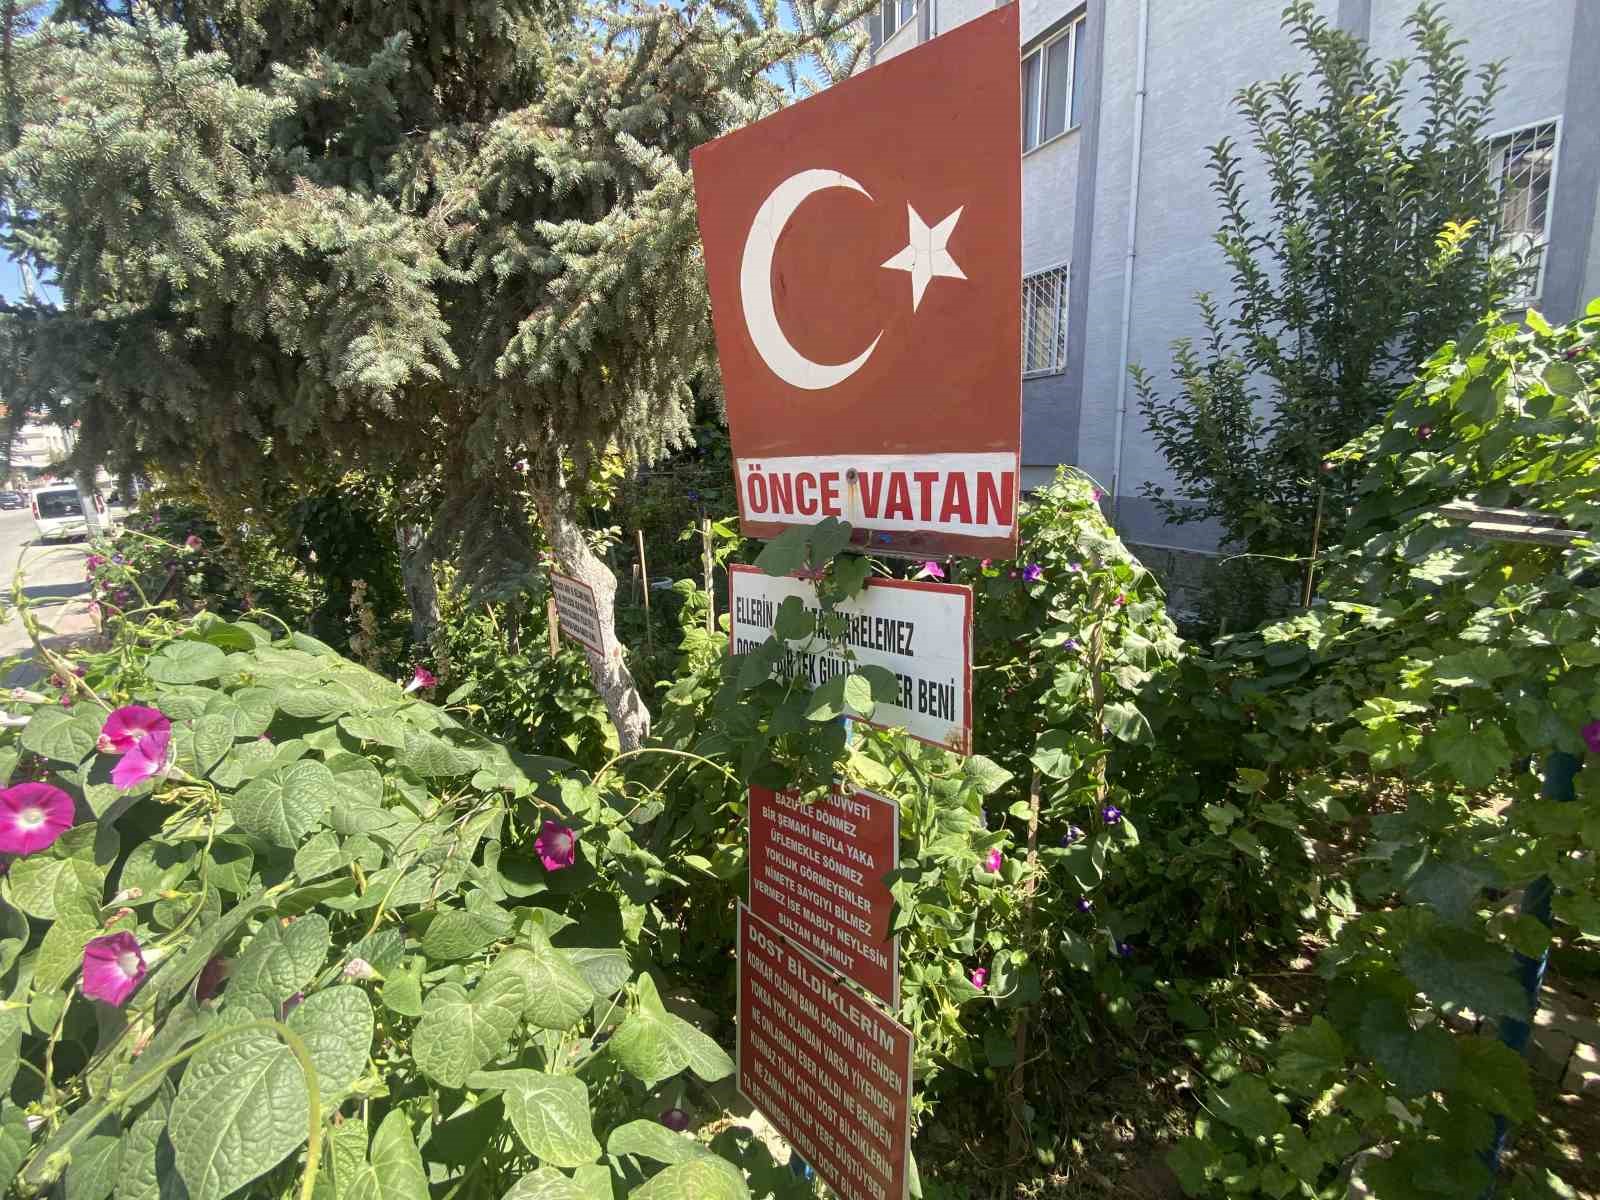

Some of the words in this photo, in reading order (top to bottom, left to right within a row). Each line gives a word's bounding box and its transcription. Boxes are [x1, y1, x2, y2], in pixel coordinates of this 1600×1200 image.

[747, 463, 841, 517] ÖNCE
[858, 471, 1015, 526] VATAN
[736, 593, 773, 629] ELLERİN
[918, 677, 955, 722] BENİ
[762, 805, 776, 822] BİR
[812, 828, 844, 855] MEVLA
[846, 843, 874, 869] YAKA
[816, 809, 857, 838] DÖNMEZ
[765, 845, 798, 873] YOKLUK
[799, 864, 871, 914] GÖRMEYENLER
[770, 828, 824, 864] ÜFLEMEKLE
[822, 855, 863, 887] SÖNMEZ
[753, 878, 786, 906] VERMEZ
[803, 907, 835, 936] MABUT
[837, 929, 888, 971] NEYLESİN
[765, 864, 795, 892] NİMETE
[796, 883, 832, 913] SAYGIYI
[834, 904, 872, 937] BİLMEZ
[778, 912, 811, 943] SULTAN
[812, 933, 854, 970] MAHMUT
[748, 924, 784, 964] DOST
[788, 955, 896, 1057] BİLDİKLERİM
[752, 1005, 761, 1025] NE
[818, 1066, 842, 1102] KALDI
[843, 1090, 855, 1115] NE
[773, 996, 787, 1023] YOK
[788, 1012, 822, 1055] OLANDAN
[823, 1042, 850, 1081] VARSA
[851, 1066, 896, 1121] YİYENDEN
[821, 1011, 855, 1054] DOSTUM
[856, 1041, 902, 1096] DİYENDEN
[814, 1119, 835, 1154] YERE
[817, 1095, 838, 1127] DOST
[839, 1115, 893, 1184] BİLDİKLERİM
[818, 1151, 839, 1185] DOST
